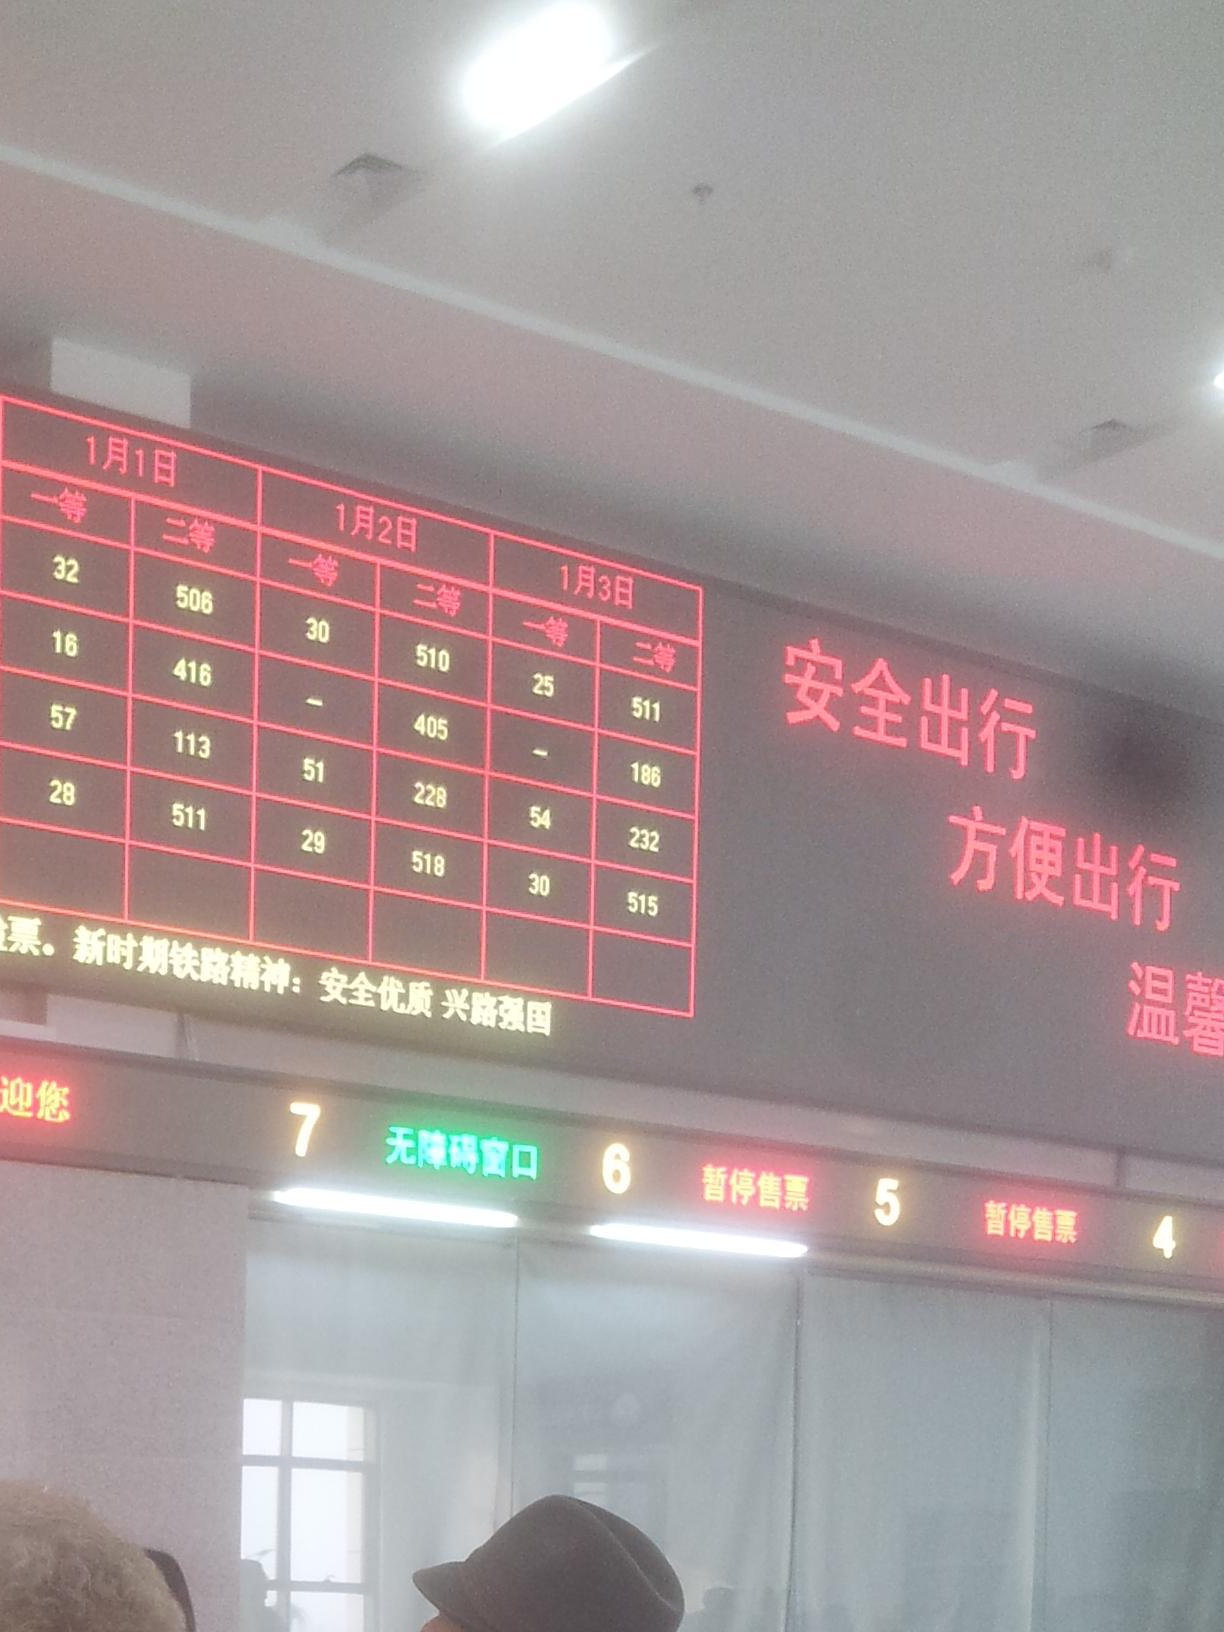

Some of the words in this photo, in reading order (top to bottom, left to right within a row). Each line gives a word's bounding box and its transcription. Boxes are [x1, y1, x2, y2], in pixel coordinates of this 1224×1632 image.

[86, 434, 178, 487] 1月1日
[30, 488, 88, 523] 一等
[162, 516, 216, 554] 二等
[335, 503, 418, 553] 1月2日
[288, 553, 340, 588] 一等
[412, 582, 462, 617] 二等
[559, 564, 634, 610] 1月3日
[52, 554, 80, 584] 32
[175, 583, 215, 616] 506
[305, 616, 331, 644] 30
[415, 642, 451, 673] 510
[531, 672, 555, 698] 25
[630, 695, 661, 723] 511
[522, 616, 569, 648] 一等
[632, 641, 676, 673] 二等
[51, 629, 79, 658] 16
[171, 657, 213, 688] 416
[412, 712, 449, 742] 405
[629, 760, 662, 789] 186
[781, 637, 1037, 781] 安全出行
[49, 702, 79, 732] 57
[173, 729, 212, 760] 113
[302, 756, 326, 784] 51
[412, 780, 448, 809] 228
[528, 804, 553, 831] 54
[628, 825, 661, 854] 232
[48, 778, 77, 807] 28
[170, 801, 207, 832] 511
[300, 827, 327, 855] 29
[410, 849, 447, 878] 518
[527, 871, 552, 898] 30
[626, 890, 660, 918] 515
[947, 805, 1181, 933] 方便出行
[1125, 961, 1224, 1057] 温馨
[288, 1100, 322, 1159] 7
[385, 1124, 539, 1181] 无障碍窗口
[600, 1141, 633, 1196] 6
[700, 1163, 811, 1213] 暂停售票
[873, 1177, 902, 1227] 5
[983, 1199, 1079, 1245] 暂停售票
[1151, 1214, 1178, 1260] 4
